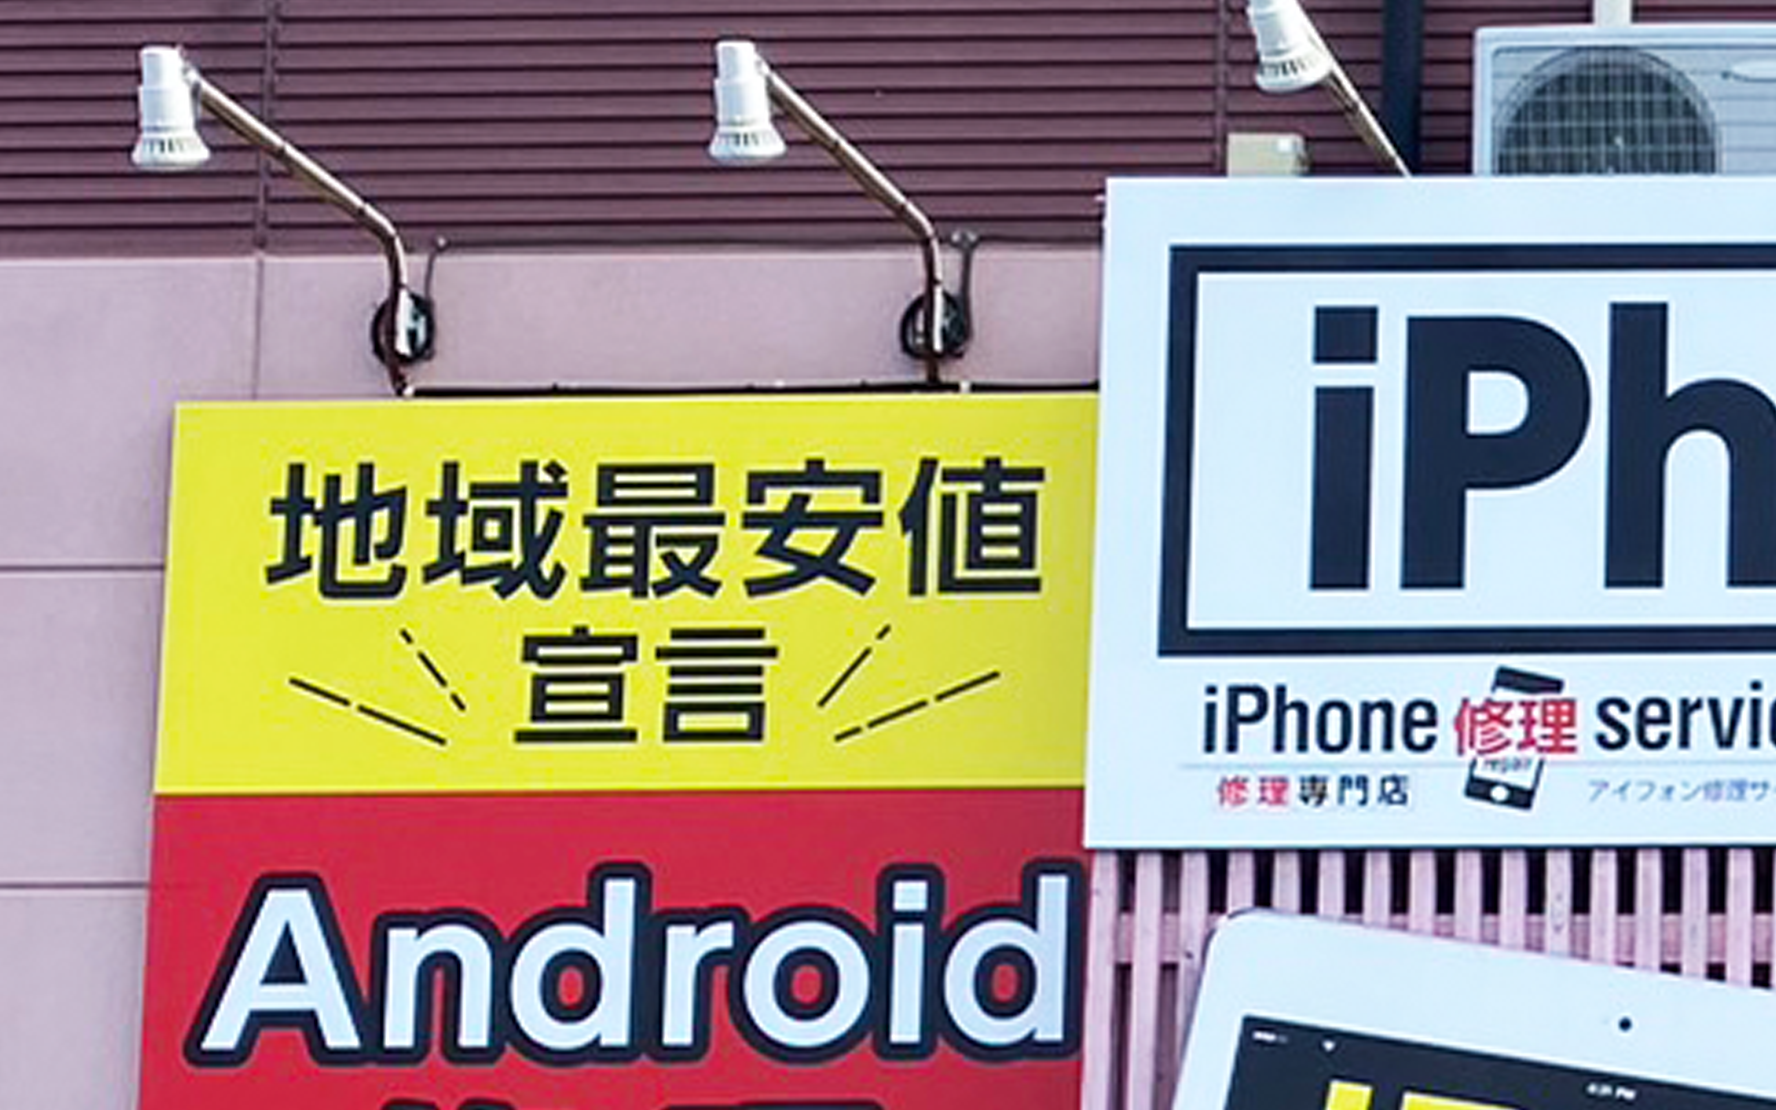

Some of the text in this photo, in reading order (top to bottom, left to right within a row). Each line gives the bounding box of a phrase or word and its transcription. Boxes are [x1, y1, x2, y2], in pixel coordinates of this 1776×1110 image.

[265, 457, 1044, 599] 地域最安値
[514, 625, 778, 743] 宣言
[1203, 685, 1437, 753] iPhone
[1453, 697, 1577, 755] 修理
[190, 868, 1076, 1058] Android
